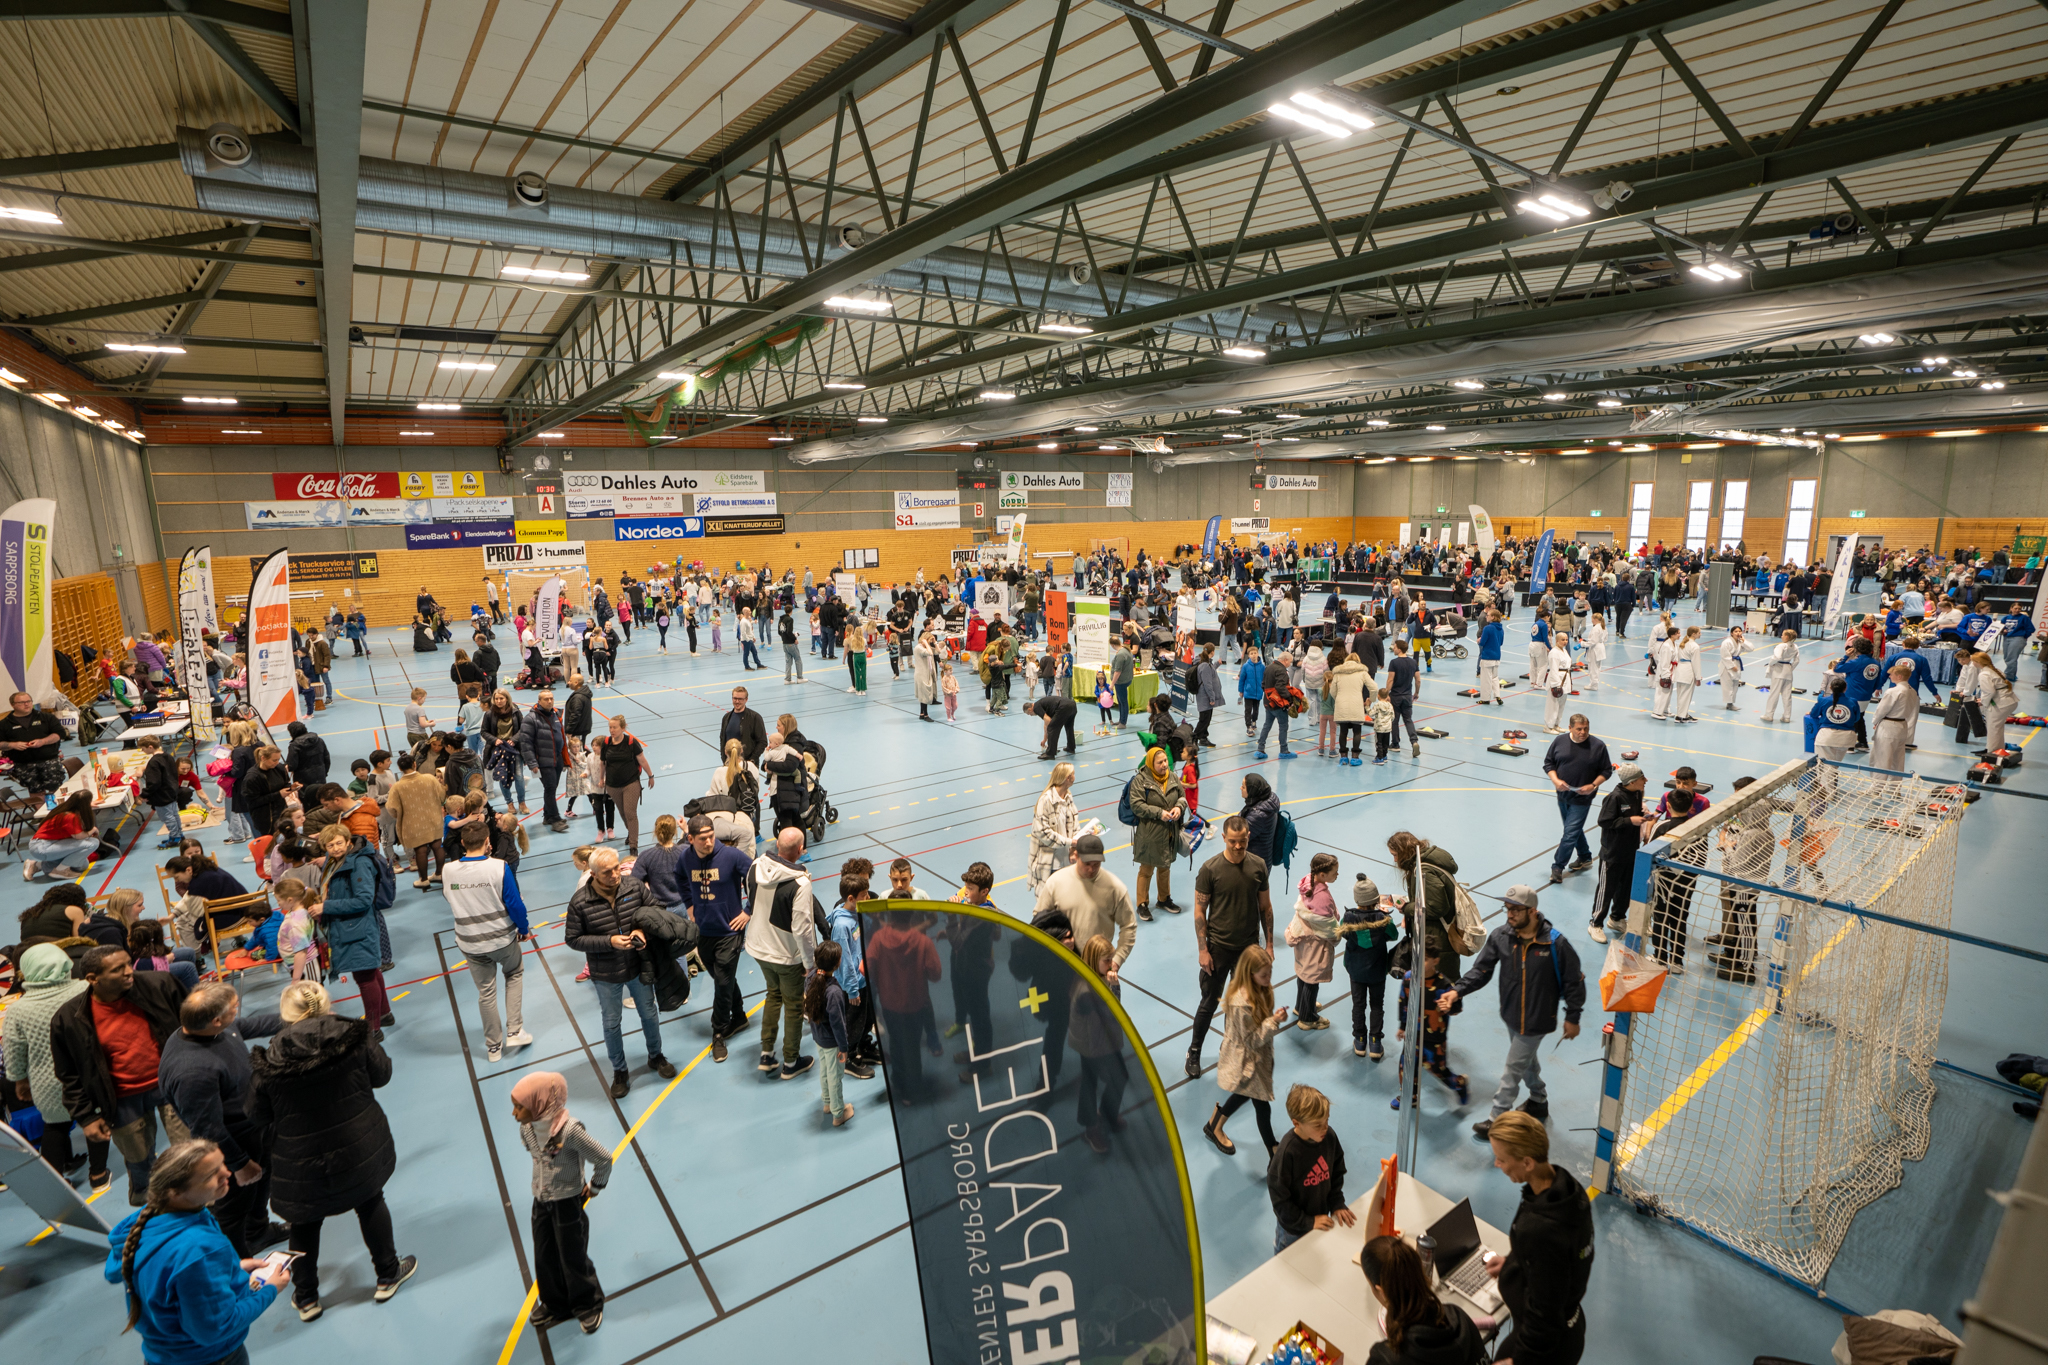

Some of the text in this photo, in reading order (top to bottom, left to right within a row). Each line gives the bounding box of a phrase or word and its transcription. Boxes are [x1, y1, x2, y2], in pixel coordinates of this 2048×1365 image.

[601, 475, 698, 490] Dahles Auto
[1023, 475, 1081, 486] Dahles Auto
[1280, 478, 1317, 487] Dahles Auto
[541, 497, 552, 511] A
[913, 497, 956, 506] Borregaard
[1254, 500, 1259, 510] C
[975, 504, 982, 515] B
[707, 521, 781, 531] XL KNATTERUDFJELLET
[1235, 518, 1269, 528] hummel PROZO
[410, 533, 450, 541] SpareBank
[465, 530, 506, 538] EiendomsMegler
[548, 529, 564, 537] Papp
[619, 525, 683, 539] Nordea
[487, 544, 584, 562] PROZO hummel
[299, 560, 345, 568] Truckservice
[5, 541, 18, 605] SARPSBORG
[29, 544, 41, 615] STOLPEJAKTEN
[542, 597, 554, 639] EVOLUTION
[1049, 618, 1065, 629] Rom
[1078, 622, 1107, 632] FRIVILLIG
[1050, 631, 1059, 641] for
